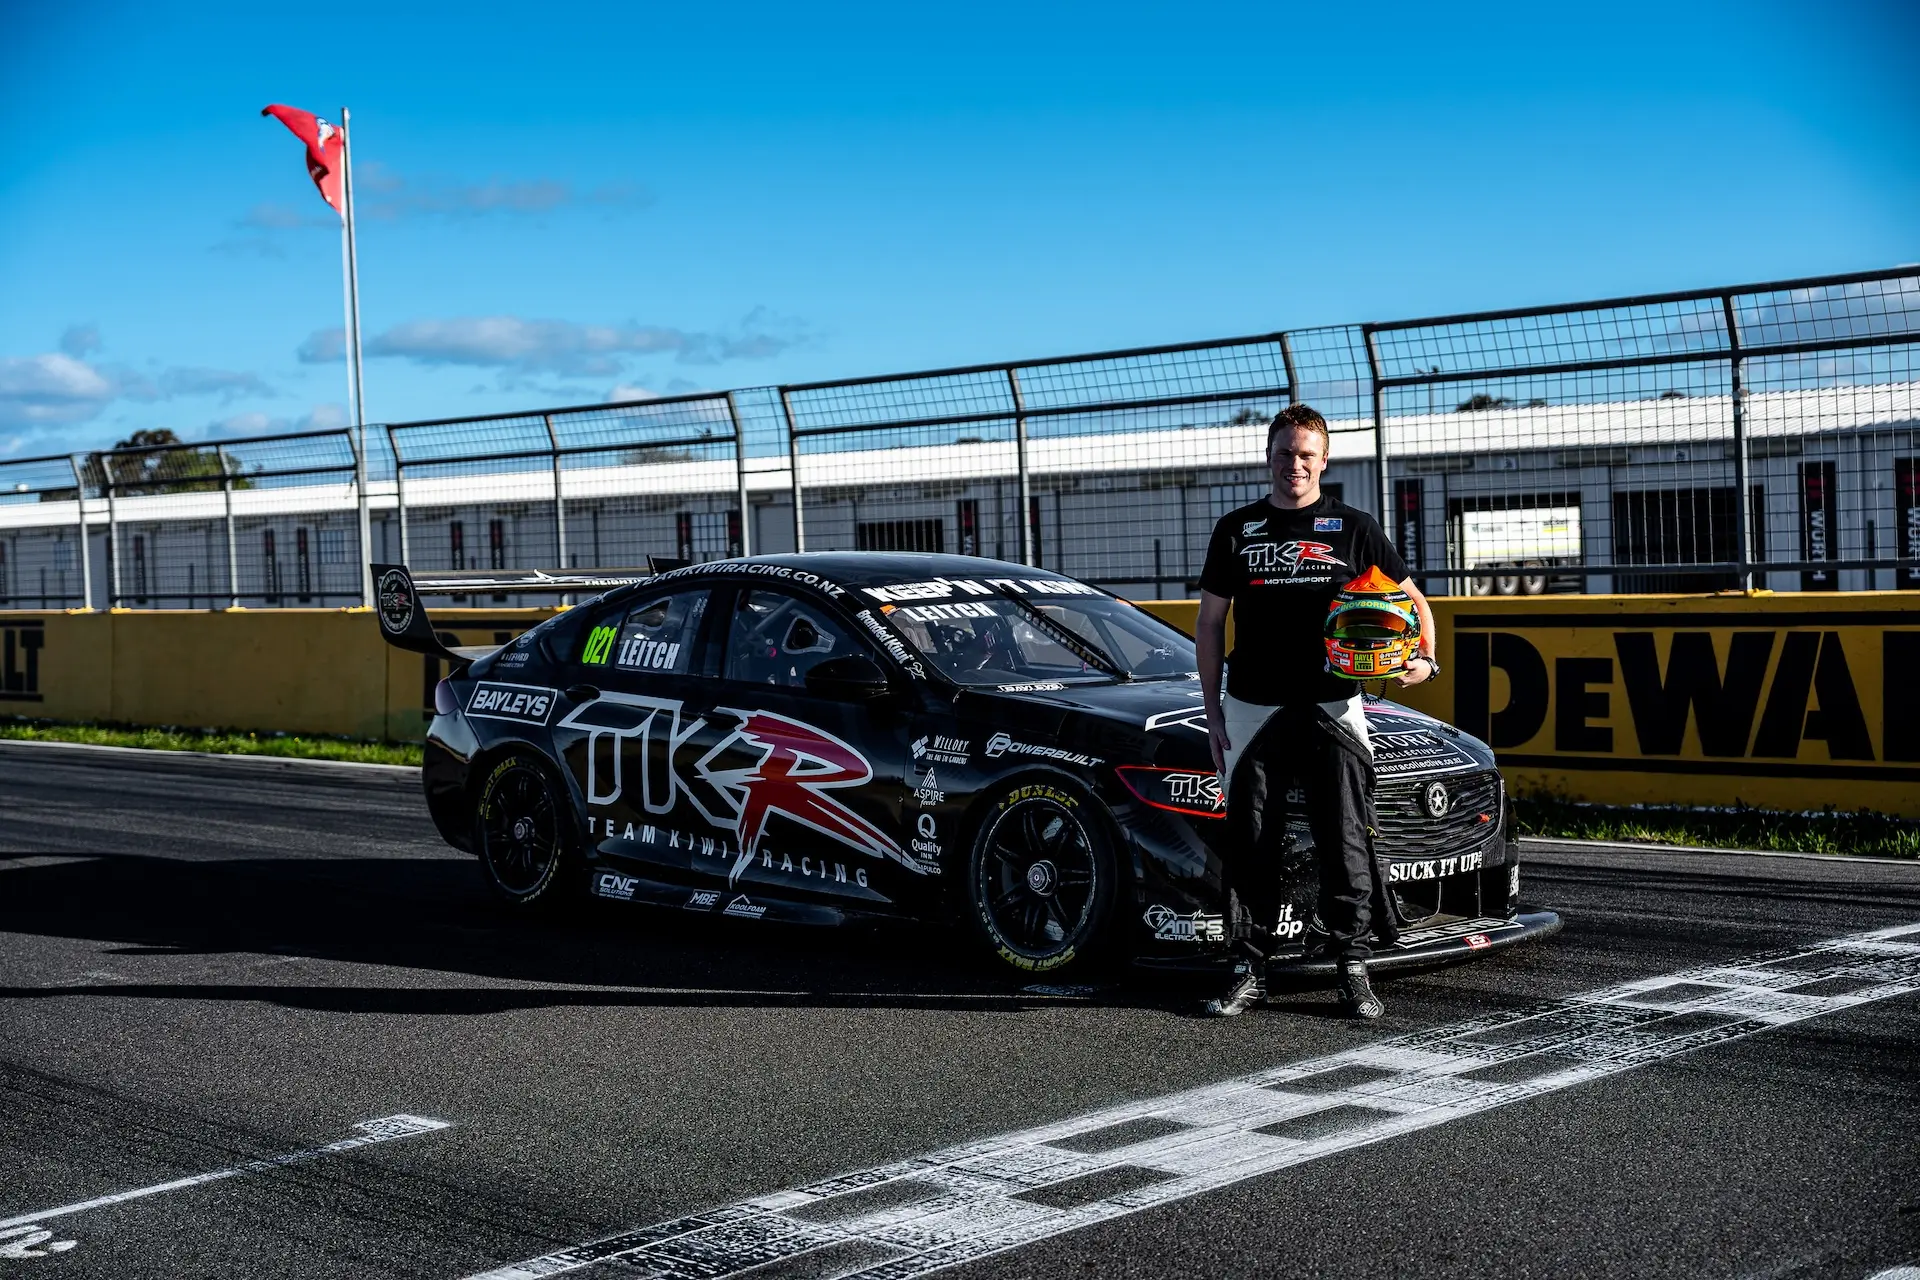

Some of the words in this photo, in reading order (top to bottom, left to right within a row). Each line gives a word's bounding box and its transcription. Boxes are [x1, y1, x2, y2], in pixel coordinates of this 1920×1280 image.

[1240, 541, 1348, 577] TKR
[633, 563, 846, 601] TEAMKIWIRACING.CO.NZ
[1264, 577, 1332, 585] MOTORSPORT
[900, 602, 998, 622] LEITCH
[581, 625, 618, 666] 021
[617, 640, 681, 670] LEITCH
[0, 629, 43, 691] LT
[473, 690, 550, 718] BAYLEYS
[933, 735, 969, 752] WILLORY
[985, 732, 1104, 767] POWERBUILT
[1370, 734, 1438, 750] AIORA
[1376, 748, 1438, 760] COLLECTIVE
[556, 689, 927, 889] TKR
[913, 788, 945, 802] ASPIRE
[1162, 773, 1225, 812] TK
[588, 815, 656, 844] TEAM
[669, 831, 729, 860] KIWI
[762, 849, 869, 888] RACING
[911, 838, 942, 857] Quality
[920, 852, 933, 860] INN
[1388, 860, 1436, 882] SUCK
[1438, 858, 1458, 877] IT
[600, 874, 639, 892] CNC
[689, 892, 718, 906] MBE
[1158, 919, 1224, 935] AMPS
[1272, 919, 1303, 938] op
[1155, 933, 1203, 942] ELECTRICAL
[1207, 934, 1225, 942] LTD
